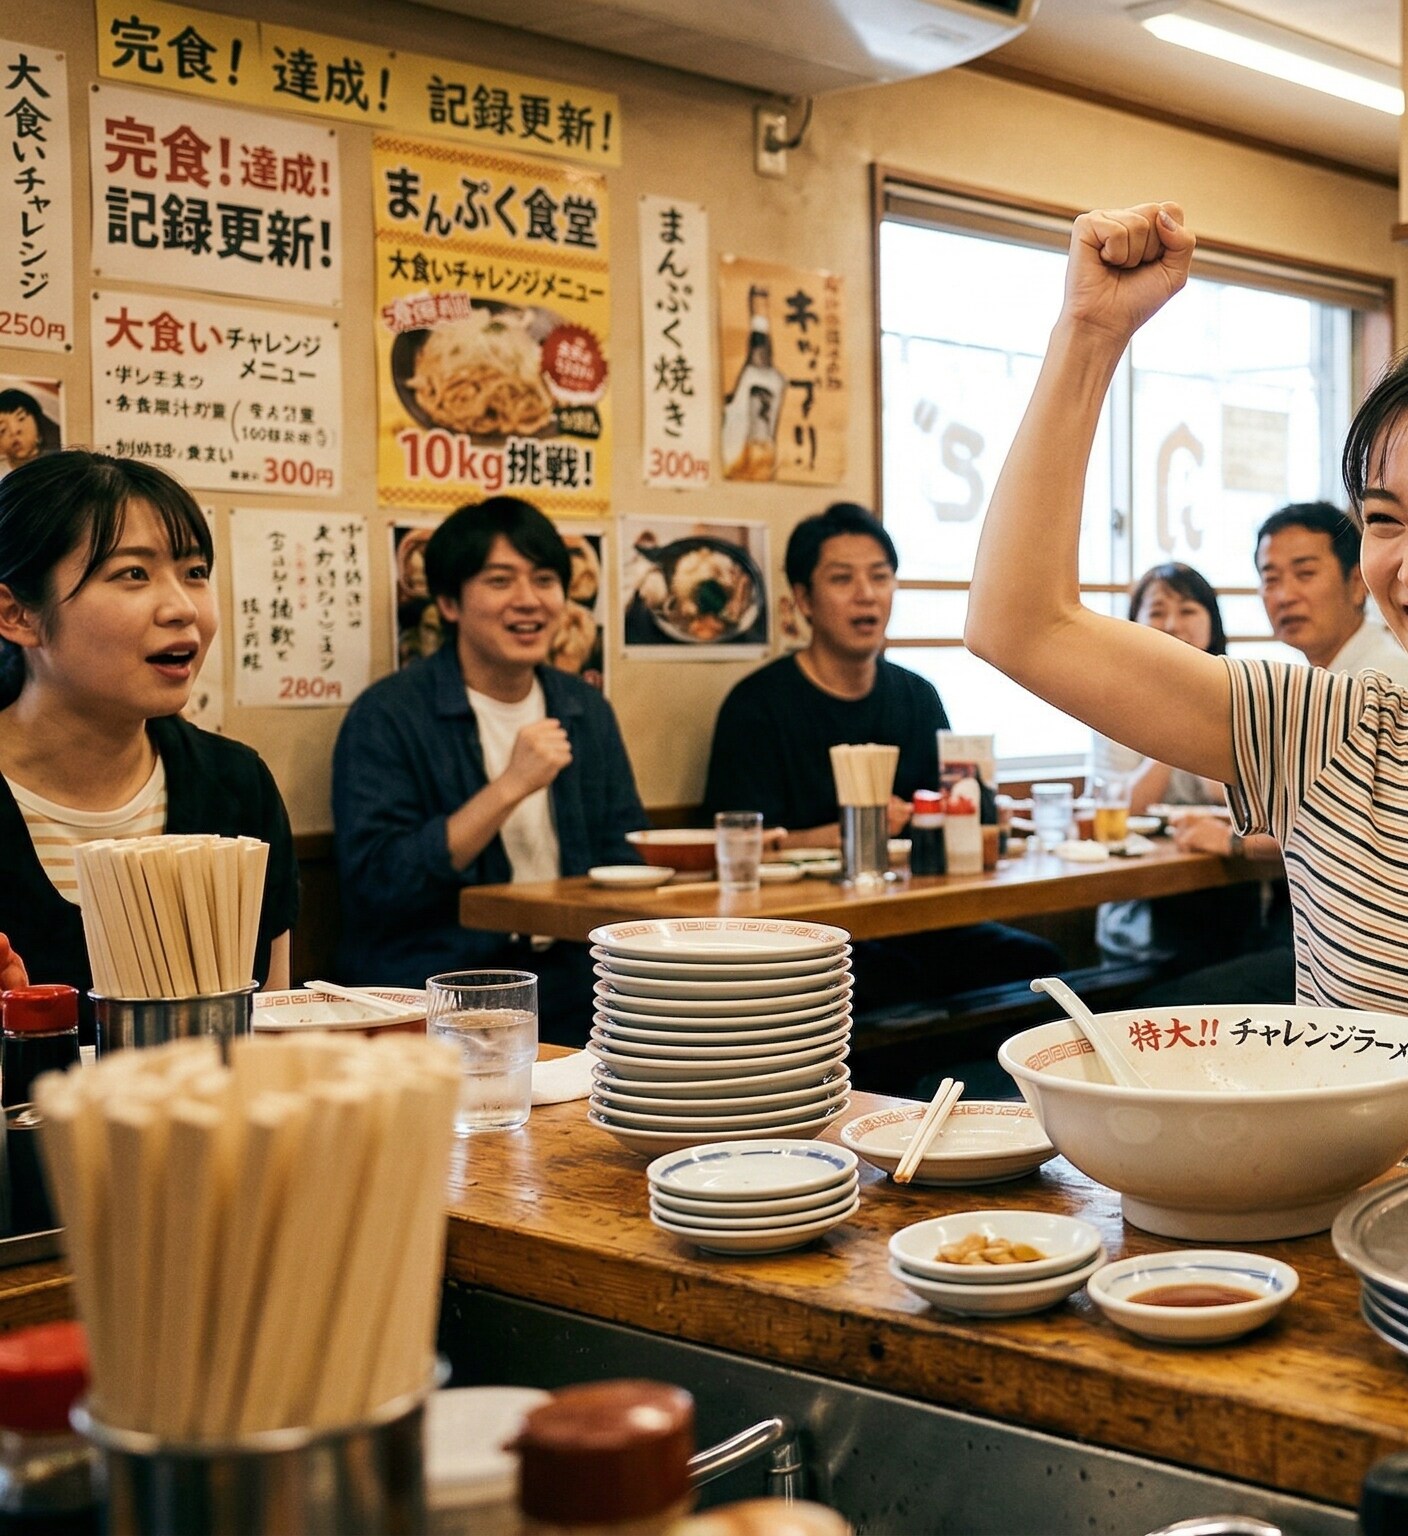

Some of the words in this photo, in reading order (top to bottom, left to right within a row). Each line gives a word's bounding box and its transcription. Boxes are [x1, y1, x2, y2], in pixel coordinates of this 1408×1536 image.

[110, 15, 243, 86] 完食!
[272, 46, 391, 112] 達成!
[427, 75, 613, 152] 記録更新!
[4, 53, 52, 300] 大食いチャレンジ
[105, 186, 333, 271] 記録更新!
[386, 167, 599, 250] まんぷく食堂
[388, 250, 606, 302] 大食いチャレンジメニュー
[0, 311, 66, 342] 250円
[652, 207, 696, 438] まんぷく焼き
[239, 357, 317, 385] メニュー
[263, 457, 335, 489] 300円
[401, 432, 593, 491] 10kg挑戦!
[649, 448, 710, 480] 300円
[278, 676, 343, 699] 280円
[1128, 1017, 1220, 1052] 特大!!
